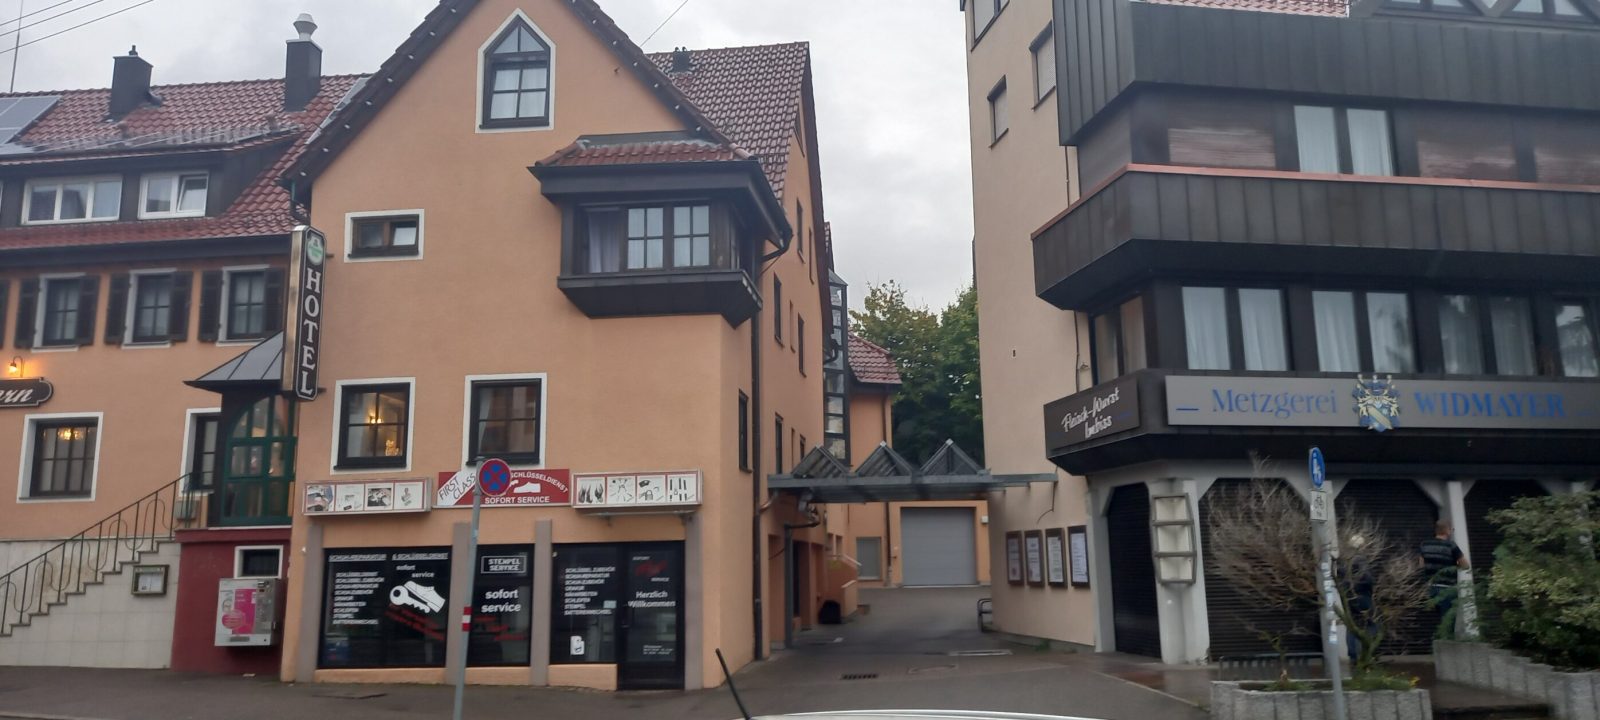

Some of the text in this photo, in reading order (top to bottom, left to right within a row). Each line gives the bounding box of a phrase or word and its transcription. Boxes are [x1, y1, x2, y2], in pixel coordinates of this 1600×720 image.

[301, 267, 321, 395] HOTEL
[1211, 388, 1567, 419] Metzgerei WIDMAYER
[438, 476, 460, 500] FIRST
[453, 473, 476, 500] CLASS
[484, 496, 550, 505] SOFORT SERVICE
[485, 589, 518, 600] sofort
[481, 602, 522, 613] service
[627, 600, 676, 608] Willkommen
